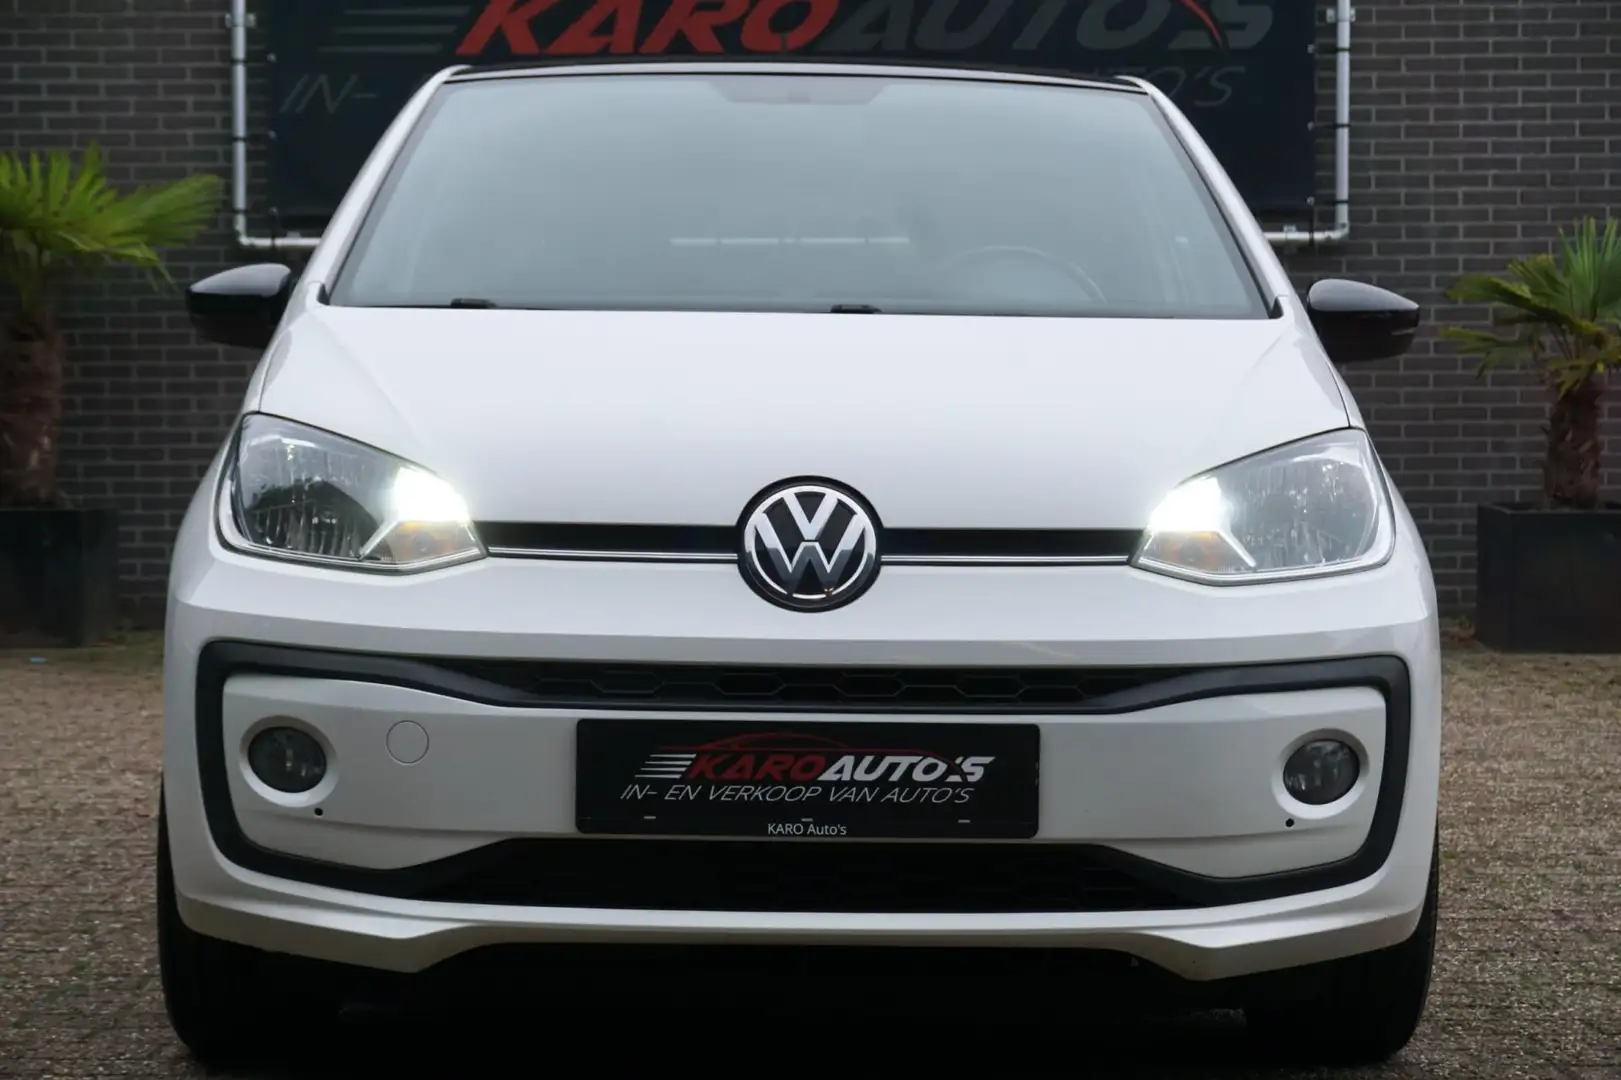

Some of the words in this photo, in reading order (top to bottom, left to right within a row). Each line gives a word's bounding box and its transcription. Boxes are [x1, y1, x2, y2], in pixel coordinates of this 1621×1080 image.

[278, 73, 378, 113] IN-
[619, 784, 658, 801] IN-
[664, 784, 702, 801] EN
[708, 785, 822, 802] VERKOOP
[829, 787, 880, 803] VAN
[880, 787, 975, 804] AUTO'S
[767, 823, 804, 836] KARO
[807, 823, 848, 836] Auto's
